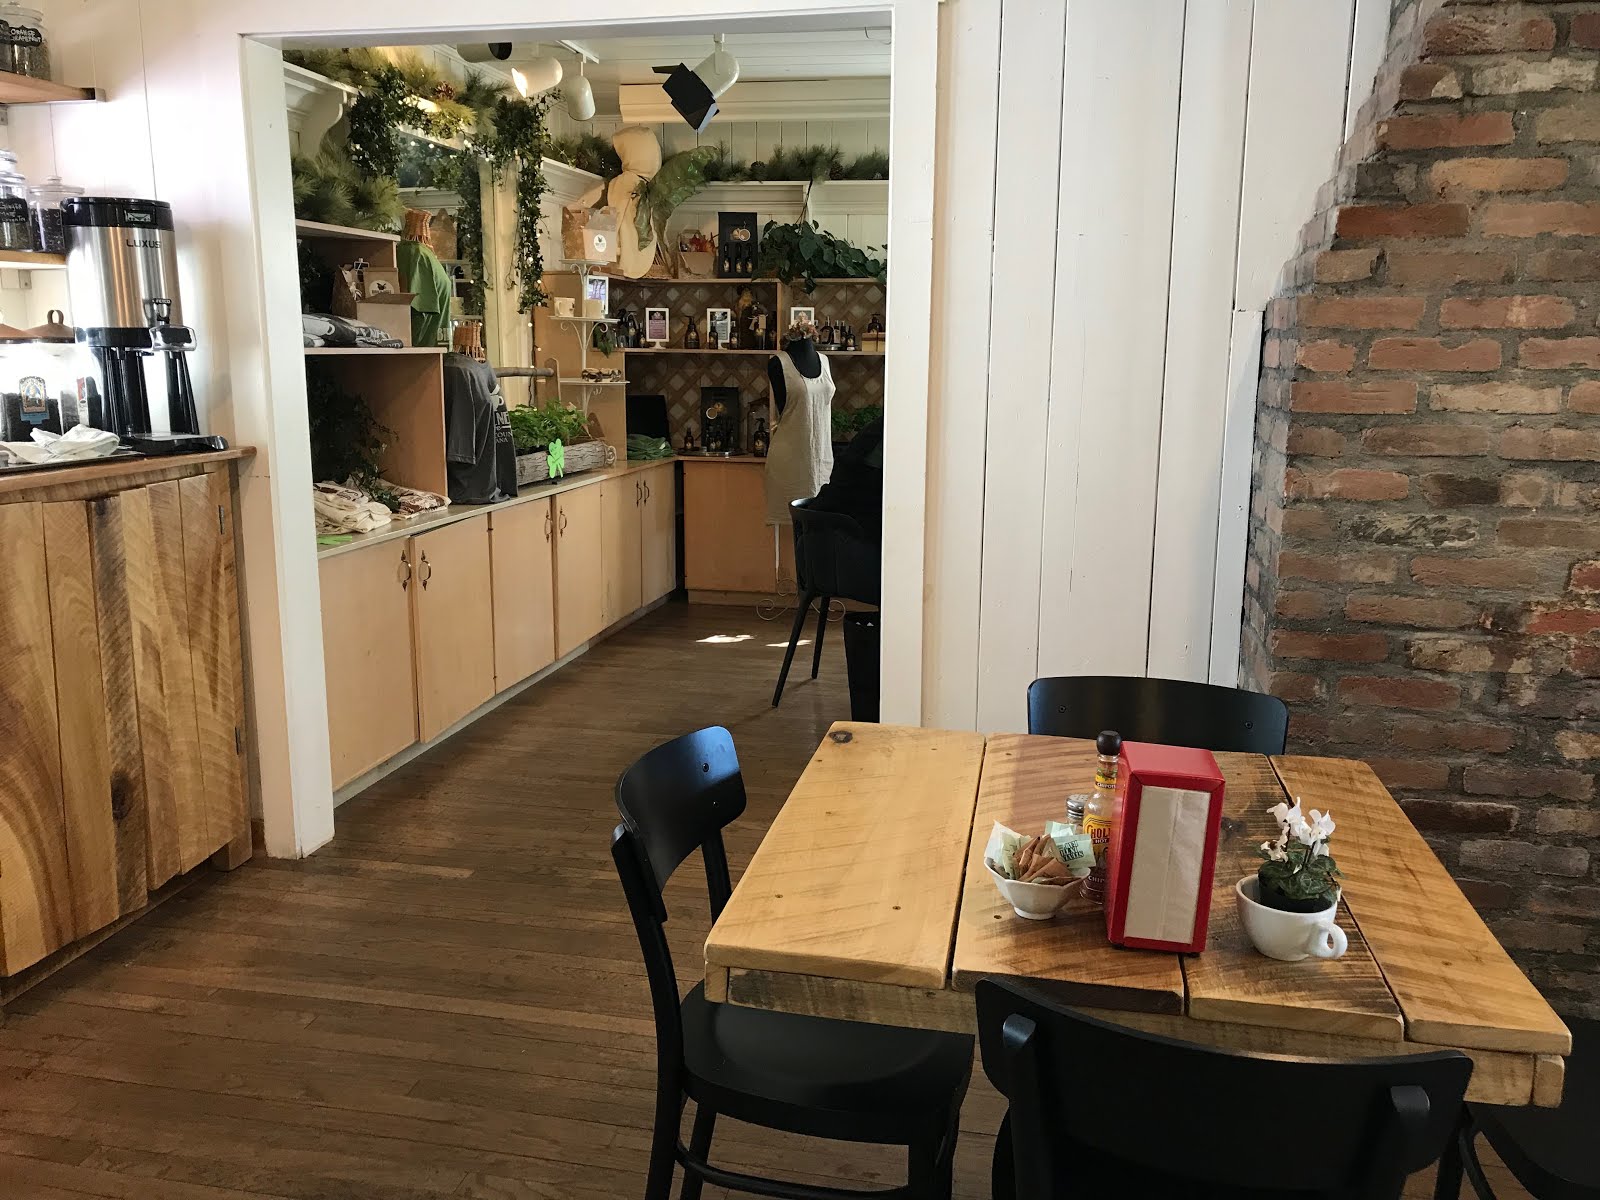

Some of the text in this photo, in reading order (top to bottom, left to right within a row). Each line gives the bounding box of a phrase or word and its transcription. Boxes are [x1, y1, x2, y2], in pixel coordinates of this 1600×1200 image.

[126, 239, 161, 248] LUXUS
[1087, 825, 1110, 838] CHOL
[1087, 875, 1105, 883] CHIP
